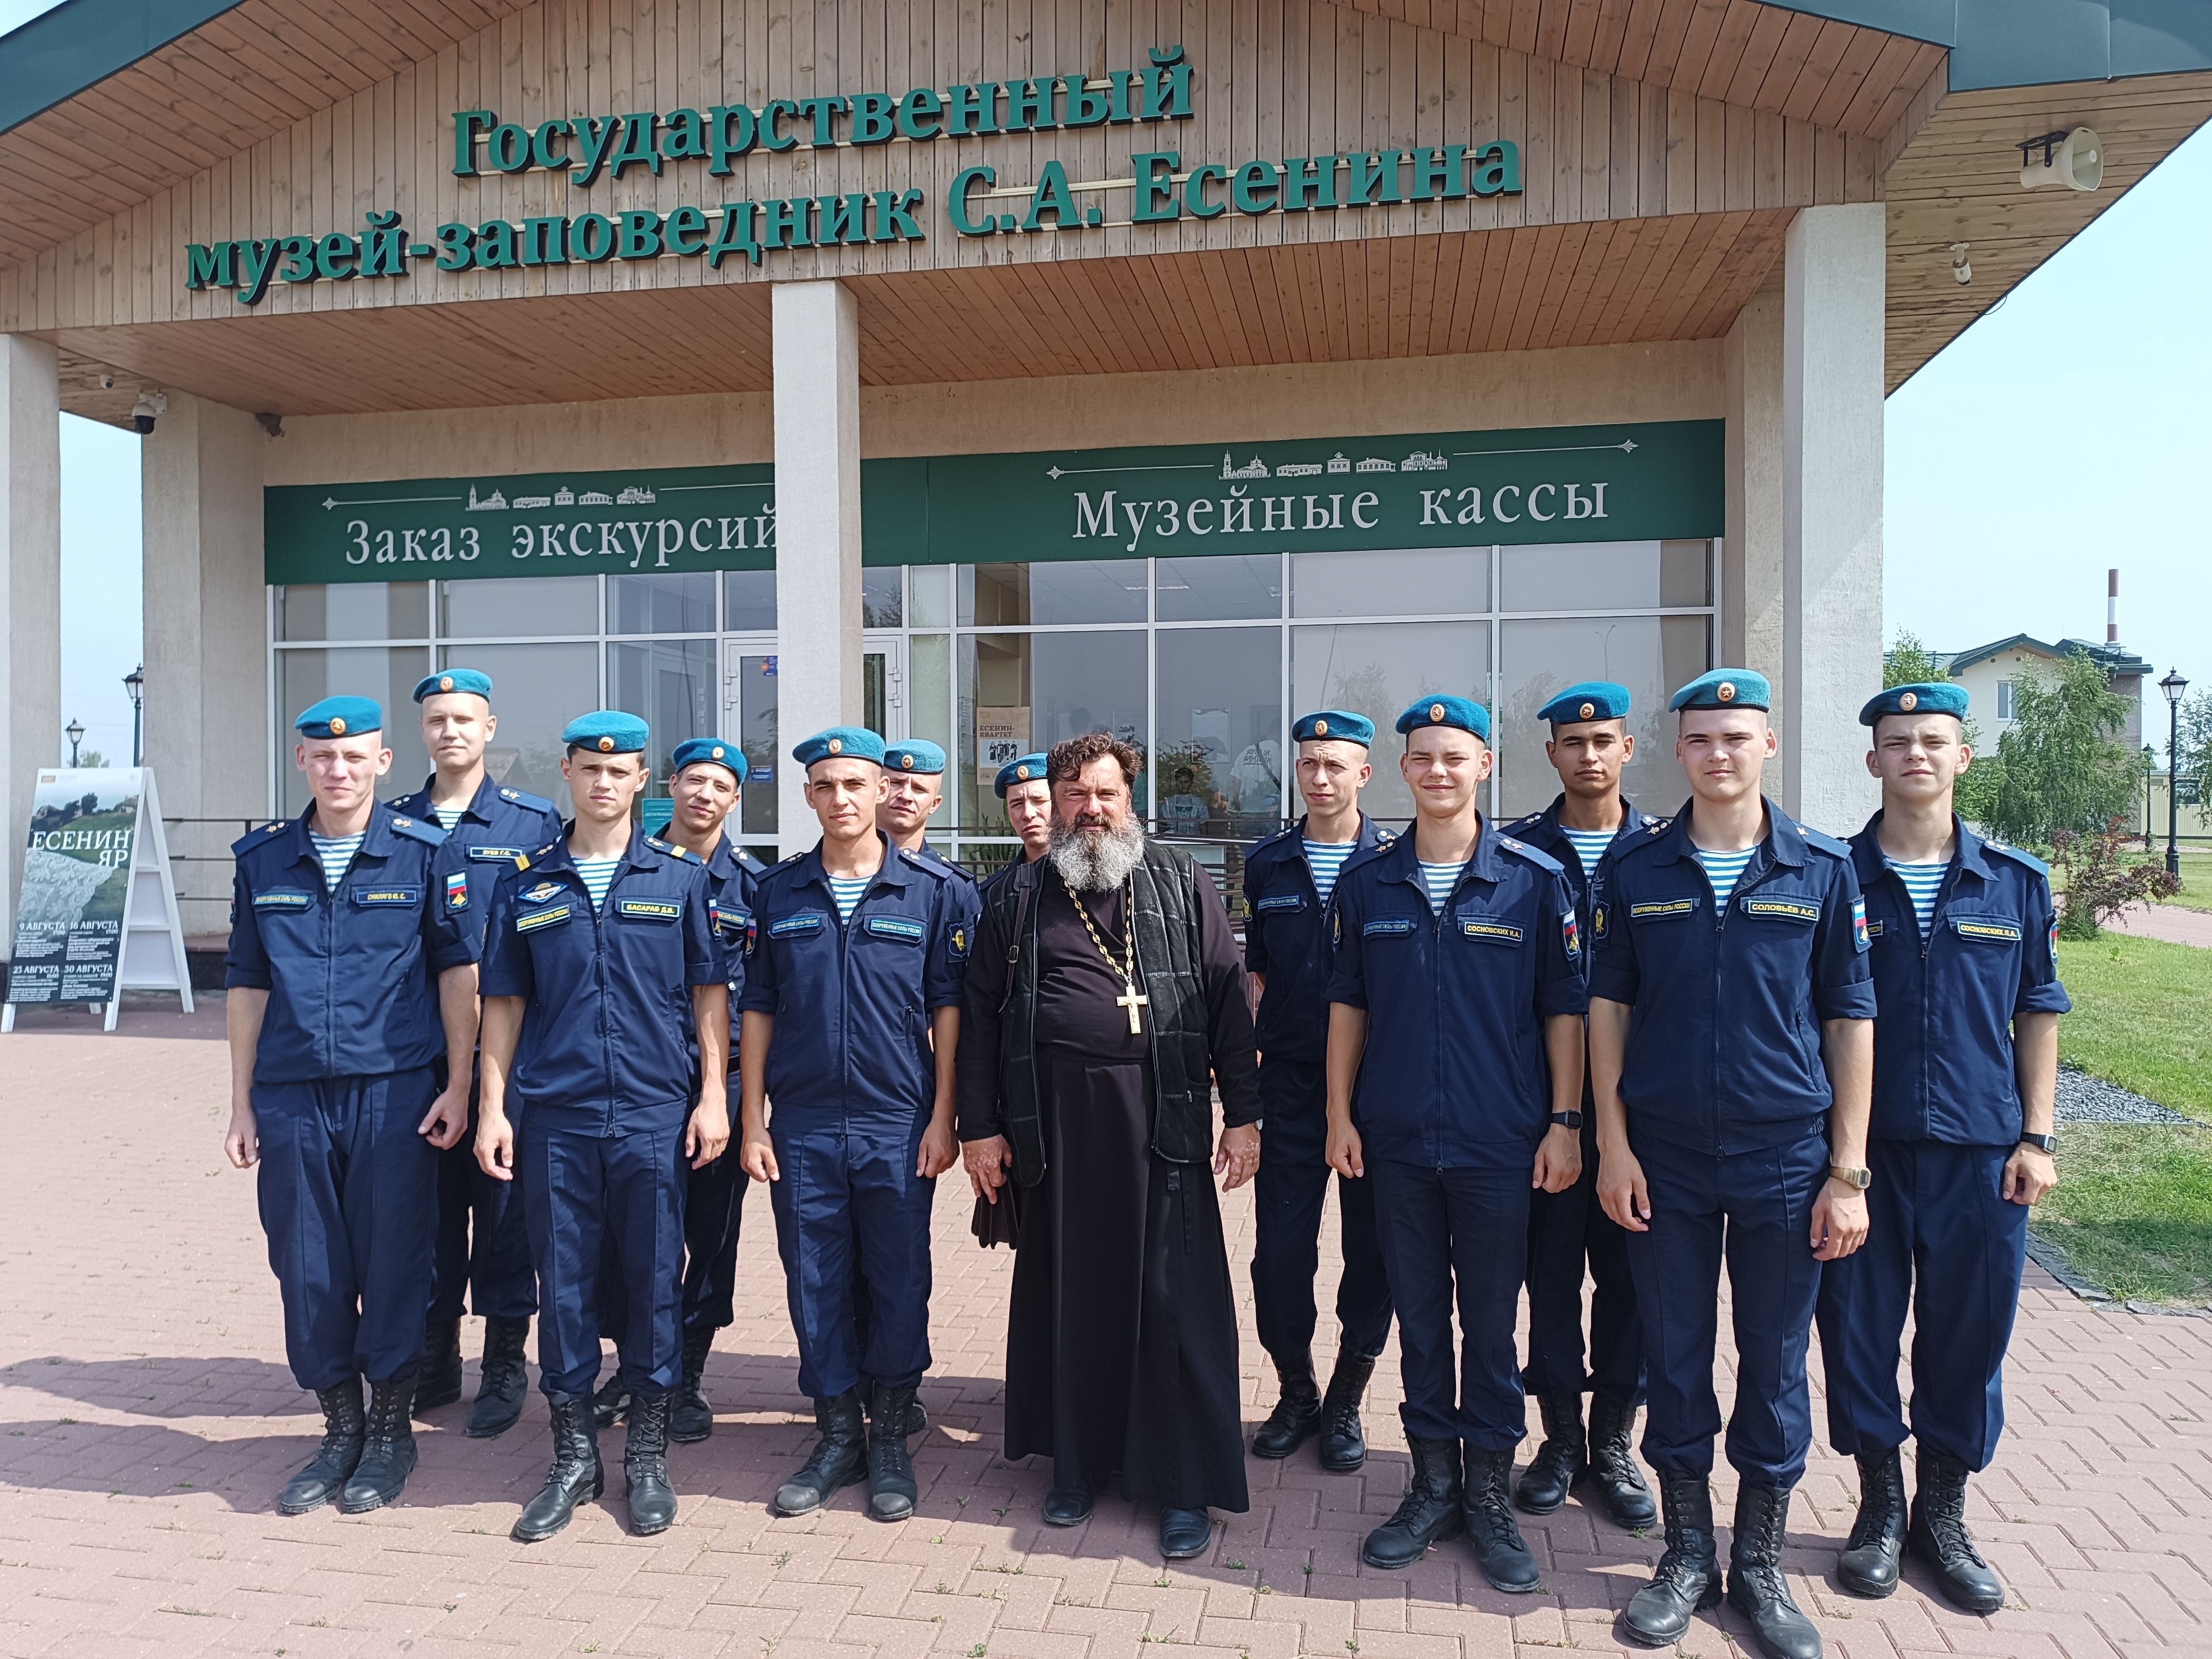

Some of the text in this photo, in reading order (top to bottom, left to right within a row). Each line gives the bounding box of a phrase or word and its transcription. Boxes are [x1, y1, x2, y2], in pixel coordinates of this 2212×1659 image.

[452, 45, 1194, 188] Государственный
[184, 139, 1524, 305] музей-заповедник С.А. Есенина
[1072, 481, 1609, 552] Музейные кассы
[346, 503, 776, 568] Заказ экскурсий
[32, 830, 131, 851] ЕСЕНИН
[98, 849, 128, 869] ЯР
[1800, 908, 1816, 917] А.С.
[19, 921, 65, 931] 9 АВГУСТА
[80, 920, 118, 930] АВГУСТА
[1467, 925, 1509, 936] СОСНОВСКИХ
[13, 965, 59, 974] 23 АВГУСТА
[64, 964, 113, 973] 30 АВГУСТА
